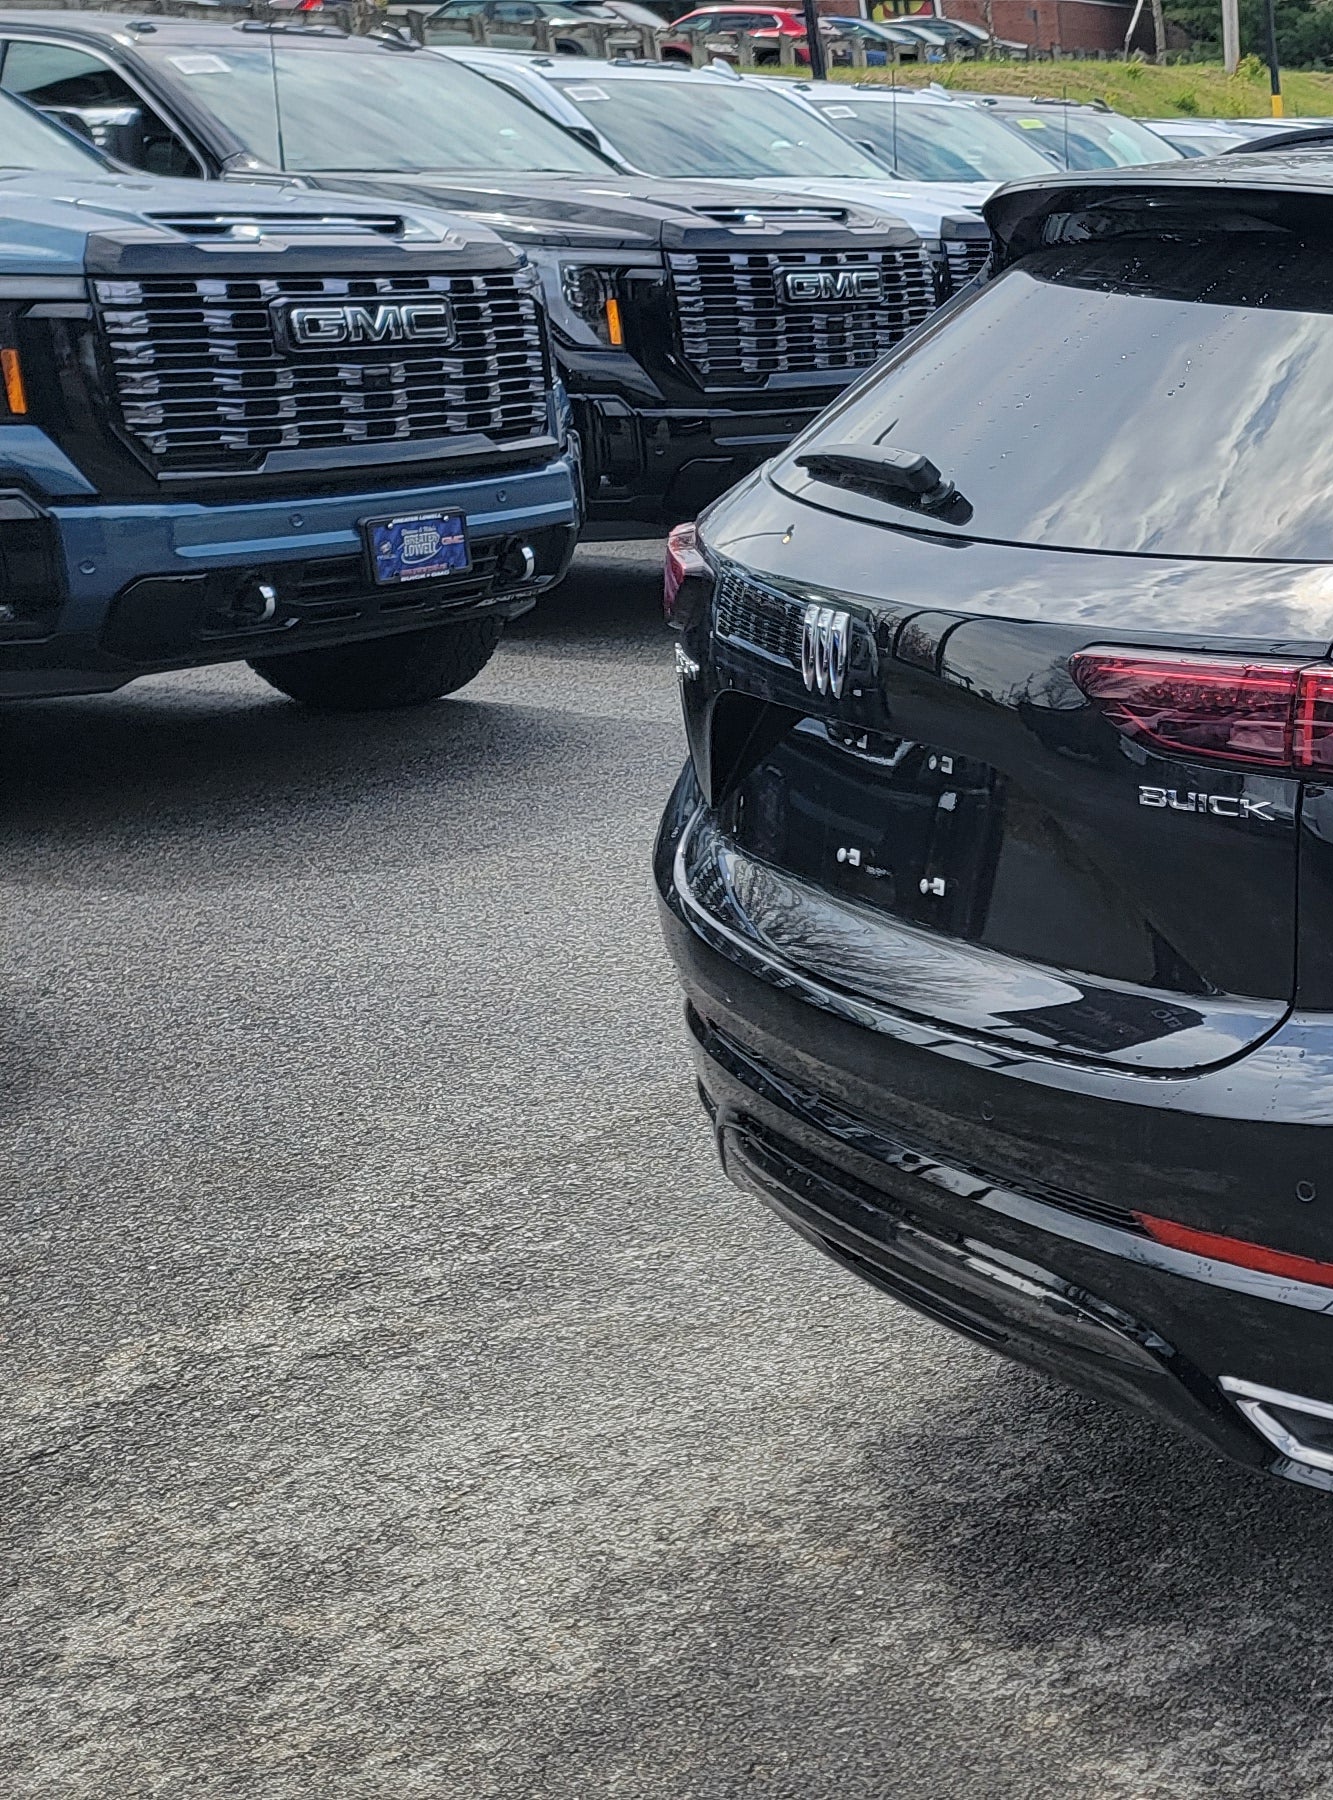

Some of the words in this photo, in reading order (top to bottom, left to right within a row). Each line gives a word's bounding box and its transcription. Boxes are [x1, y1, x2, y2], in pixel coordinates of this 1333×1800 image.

[785, 271, 880, 299] GMC
[290, 304, 449, 344] GMC
[404, 533, 438, 546] GREATER
[442, 535, 464, 545] GMC
[404, 542, 437, 557] LOWELL
[431, 569, 450, 577] GMC
[1138, 785, 1276, 821] BUICK
